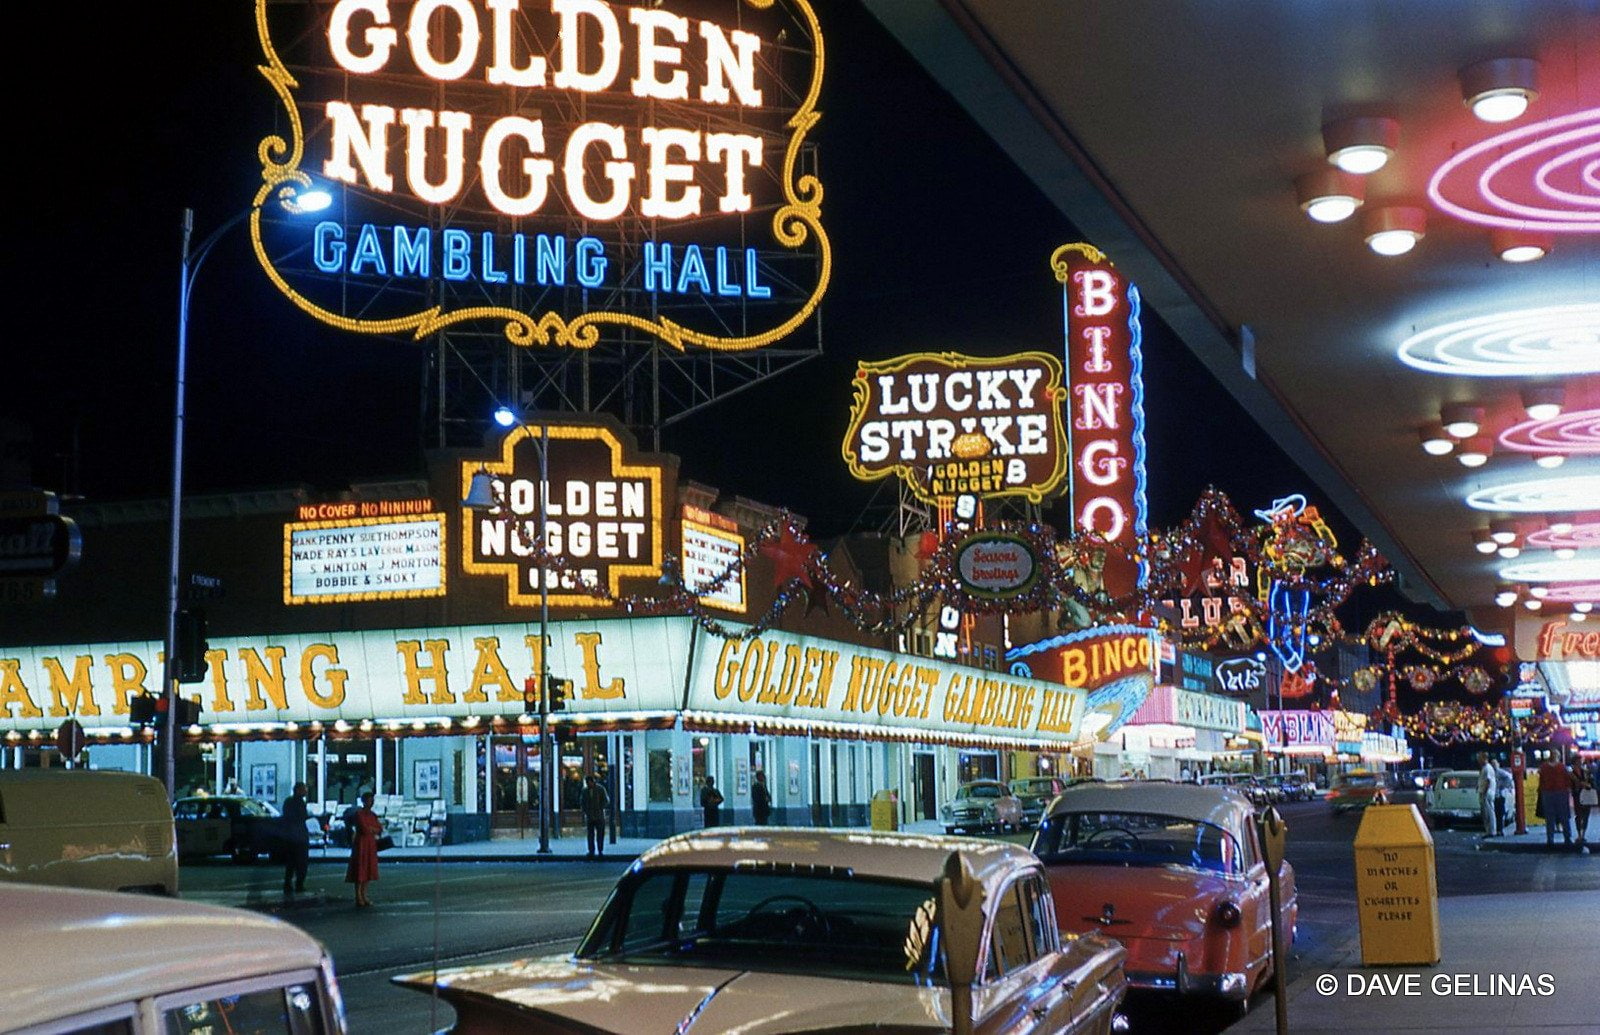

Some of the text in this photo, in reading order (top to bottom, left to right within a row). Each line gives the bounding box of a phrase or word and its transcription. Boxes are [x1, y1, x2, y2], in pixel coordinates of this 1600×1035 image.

[327, 0, 763, 107] GOLDEN
[322, 100, 763, 220] NUGGET
[313, 221, 772, 298] GAMBLING HALL
[878, 368, 1042, 414] LUCKY
[1074, 269, 1127, 543] BINGO
[935, 459, 1004, 479] GOLDEN
[932, 475, 1003, 495] NUGGET
[300, 506, 316, 519] NO
[319, 503, 356, 518] COVER
[361, 502, 378, 517] NO
[318, 533, 356, 546] PENNY
[481, 518, 645, 559] NUGGET
[293, 549, 323, 561] WADE
[323, 561, 368, 574] MINTON
[391, 556, 439, 570] MORTON
[316, 572, 418, 588] BOBBIE & SMOKY
[1060, 636, 1150, 688] BINGO
[714, 636, 1077, 734] GOLDEN NUGGET GAMBLING HALL
[1382, 852, 1398, 862] NO
[1366, 866, 1418, 876] MATCHES
[1384, 881, 1398, 891] OR
[1377, 911, 1412, 921] PLEASE
